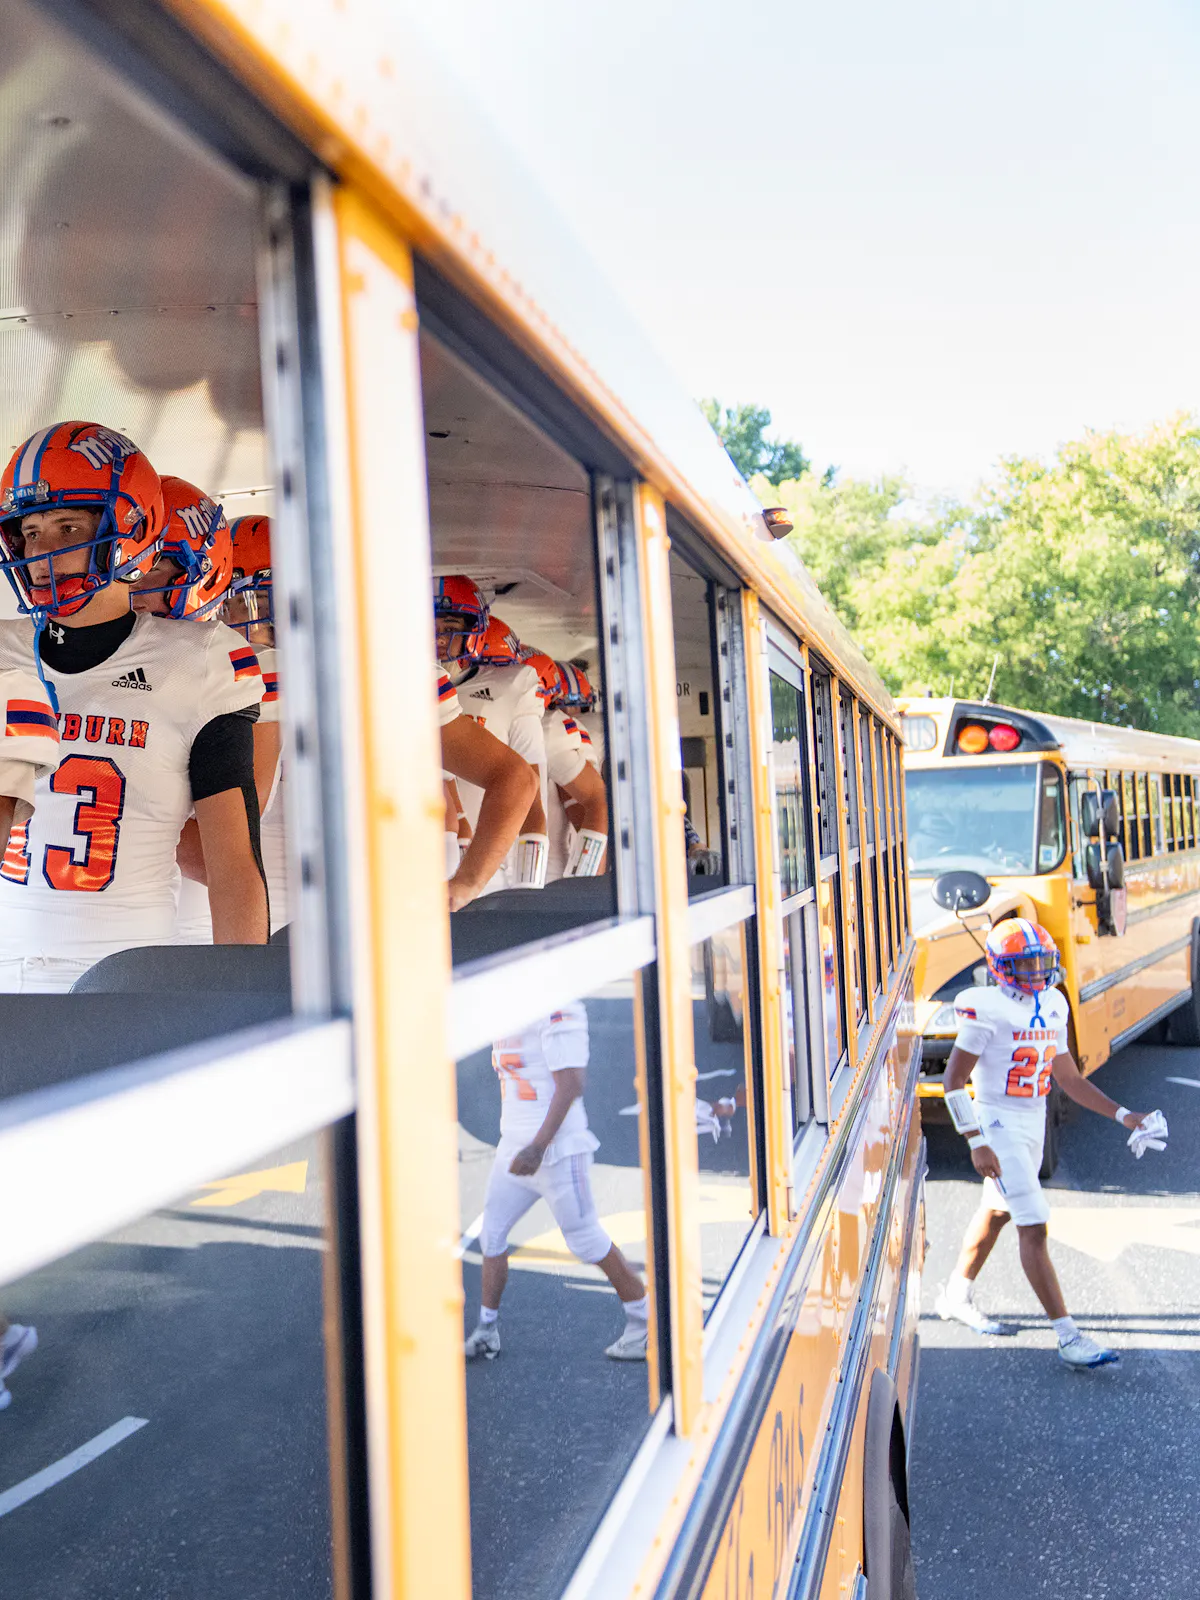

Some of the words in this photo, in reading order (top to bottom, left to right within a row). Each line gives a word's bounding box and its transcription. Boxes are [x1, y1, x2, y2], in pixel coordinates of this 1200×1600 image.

[16, 487, 35, 498] WIN
[111, 678, 153, 692] adidas
[55, 712, 150, 749] BURN
